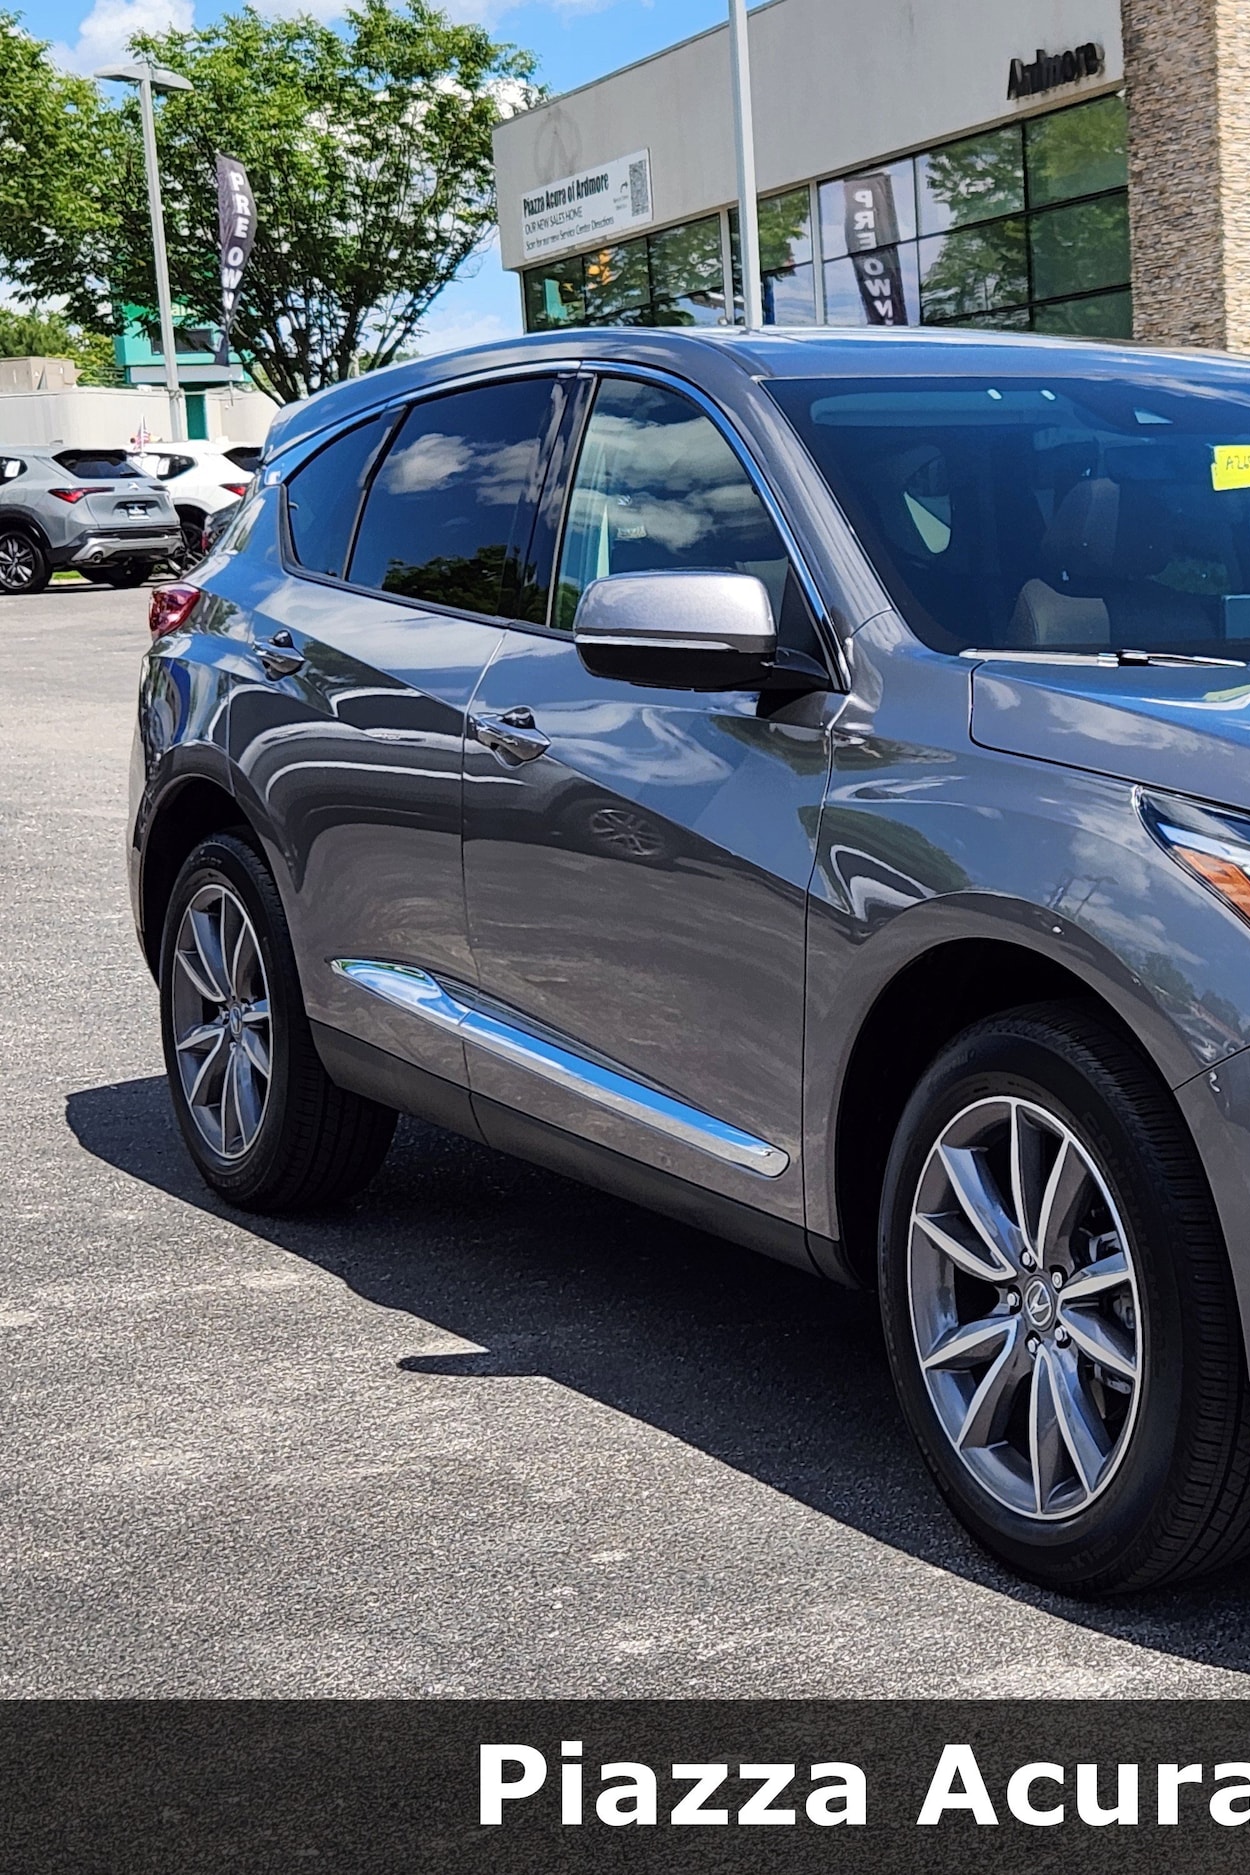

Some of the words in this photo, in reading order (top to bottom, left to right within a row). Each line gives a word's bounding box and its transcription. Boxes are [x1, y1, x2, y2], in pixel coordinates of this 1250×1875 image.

[229, 170, 251, 239] PRE
[523, 195, 545, 219] Piazza
[546, 190, 567, 212] Acura
[567, 181, 575, 204] of
[576, 173, 610, 201] Ardmore
[550, 212, 566, 227] SALES
[565, 206, 583, 221] HOME
